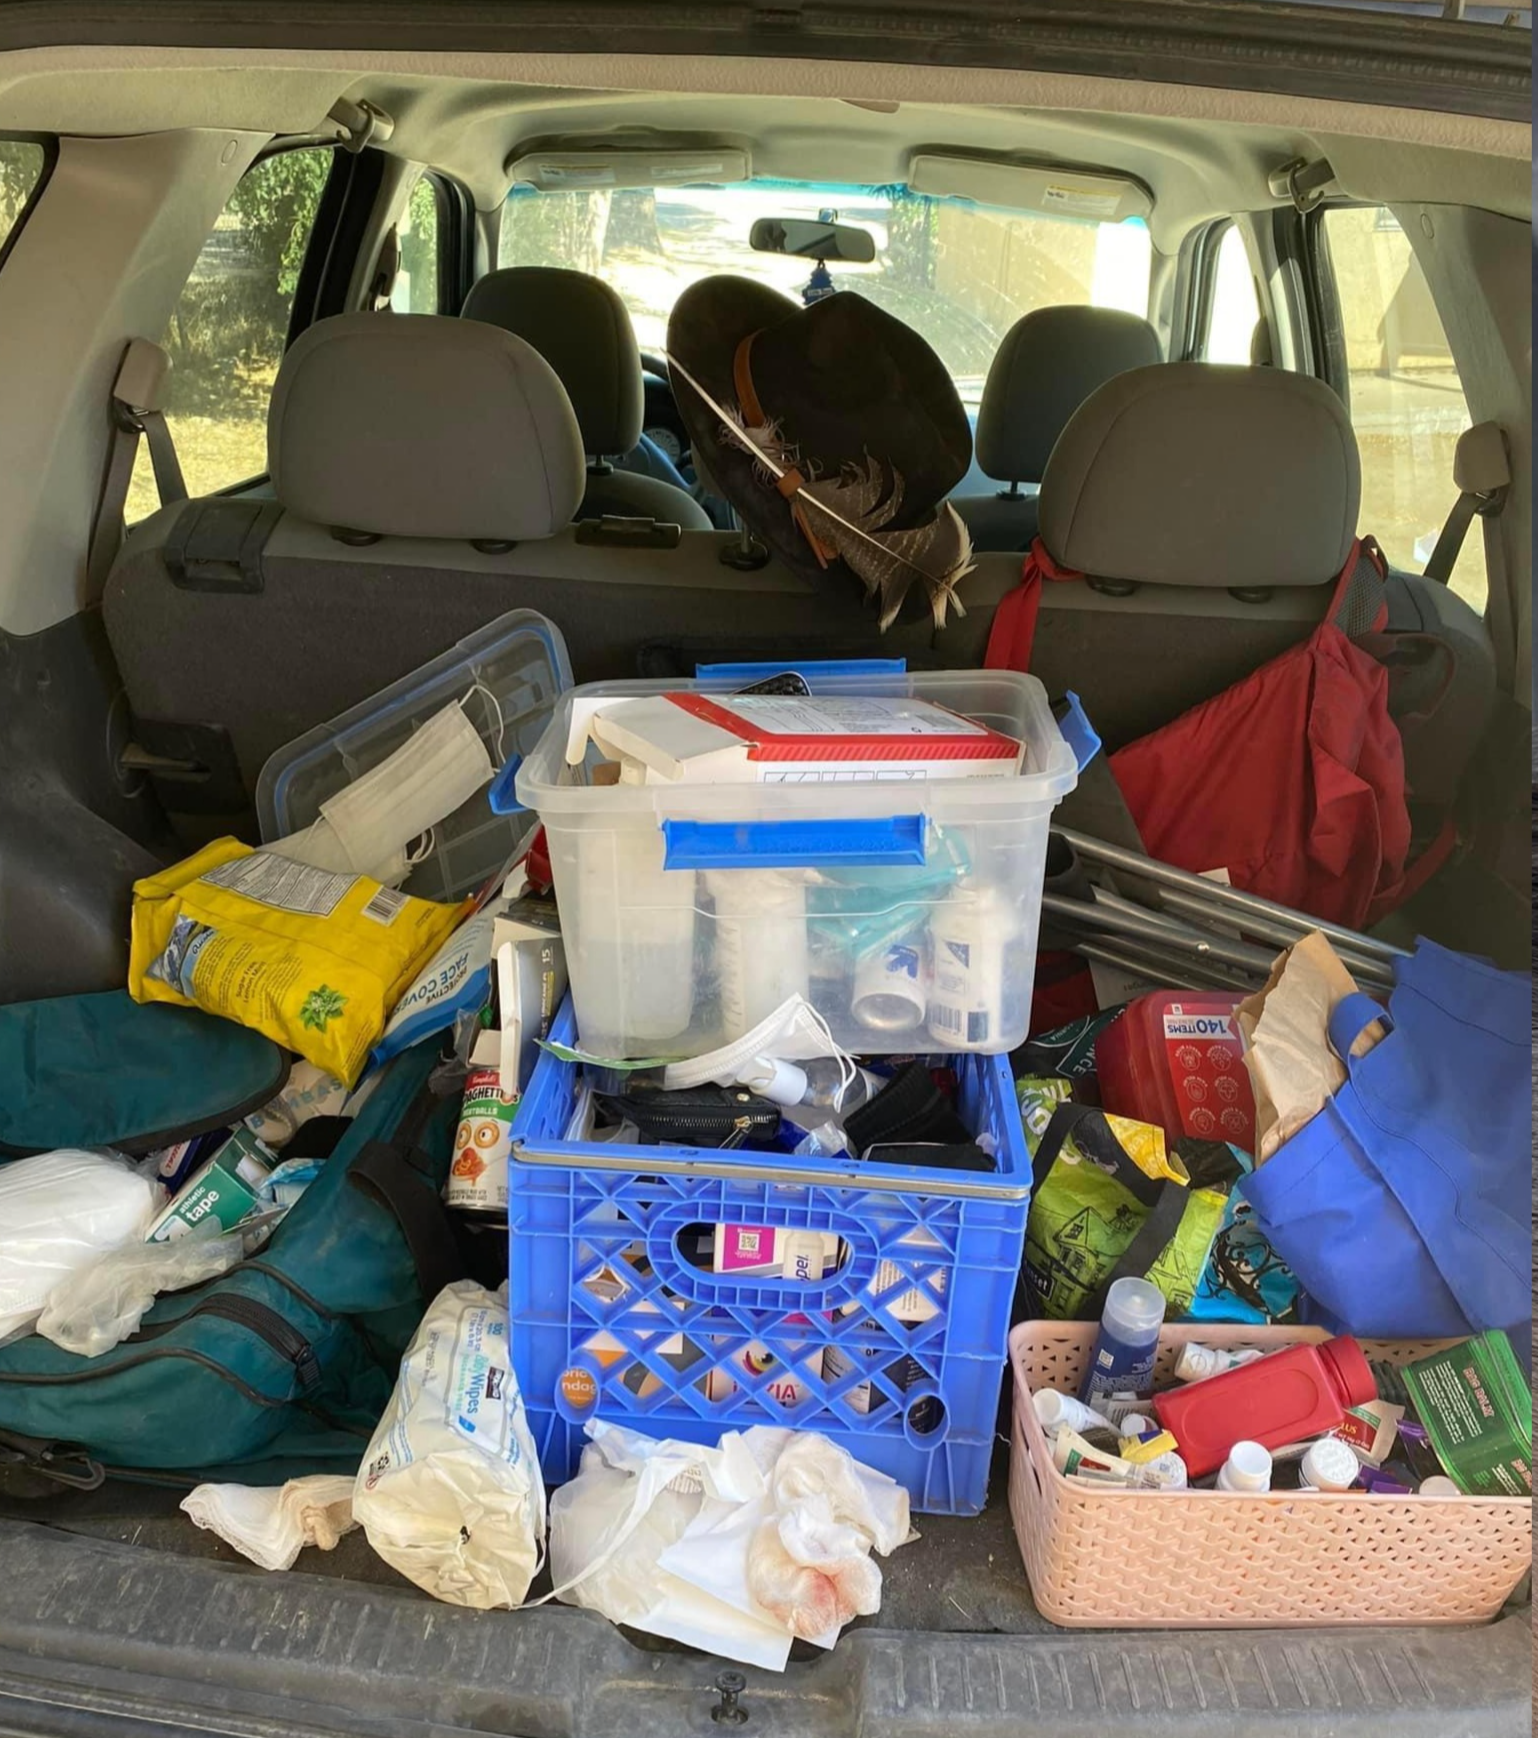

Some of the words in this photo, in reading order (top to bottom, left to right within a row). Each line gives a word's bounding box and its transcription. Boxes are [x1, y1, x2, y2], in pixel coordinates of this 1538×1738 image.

[1167, 1024, 1196, 1035] ITEMS
[1196, 1019, 1228, 1035] 140
[179, 1186, 206, 1214] athletic
[186, 1190, 220, 1222] tape
[465, 1374, 487, 1415] Wipes
